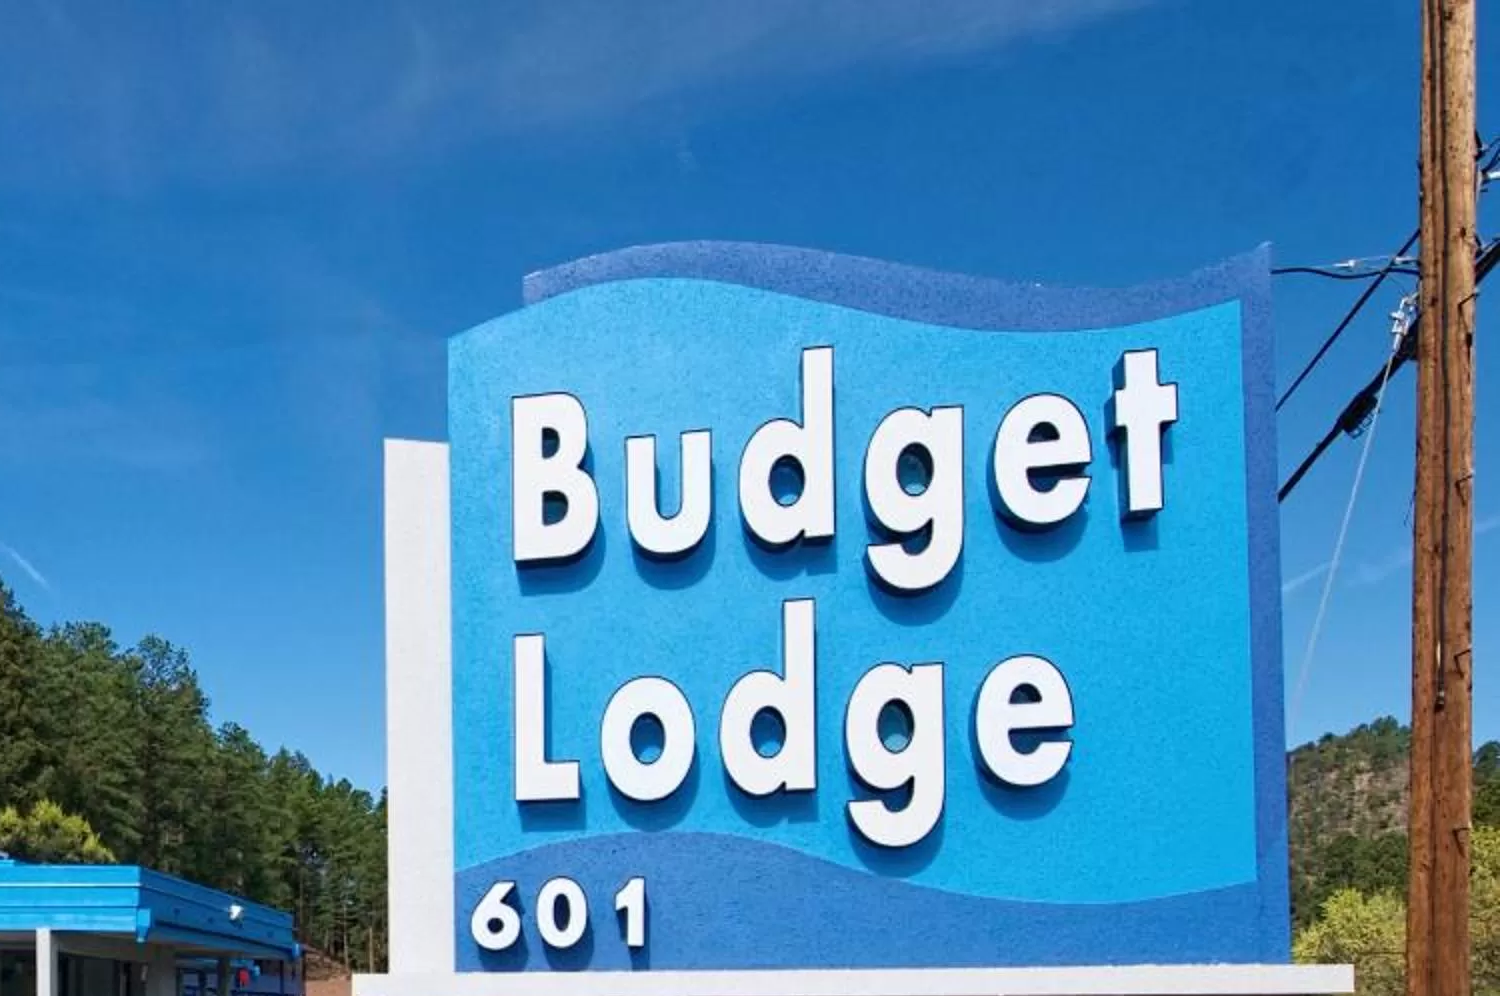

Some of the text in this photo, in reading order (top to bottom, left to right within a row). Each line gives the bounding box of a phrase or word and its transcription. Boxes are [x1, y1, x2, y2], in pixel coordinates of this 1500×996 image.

[512, 346, 1178, 590] Budget
[513, 598, 1074, 846] Lodge
[470, 877, 646, 949] 601
